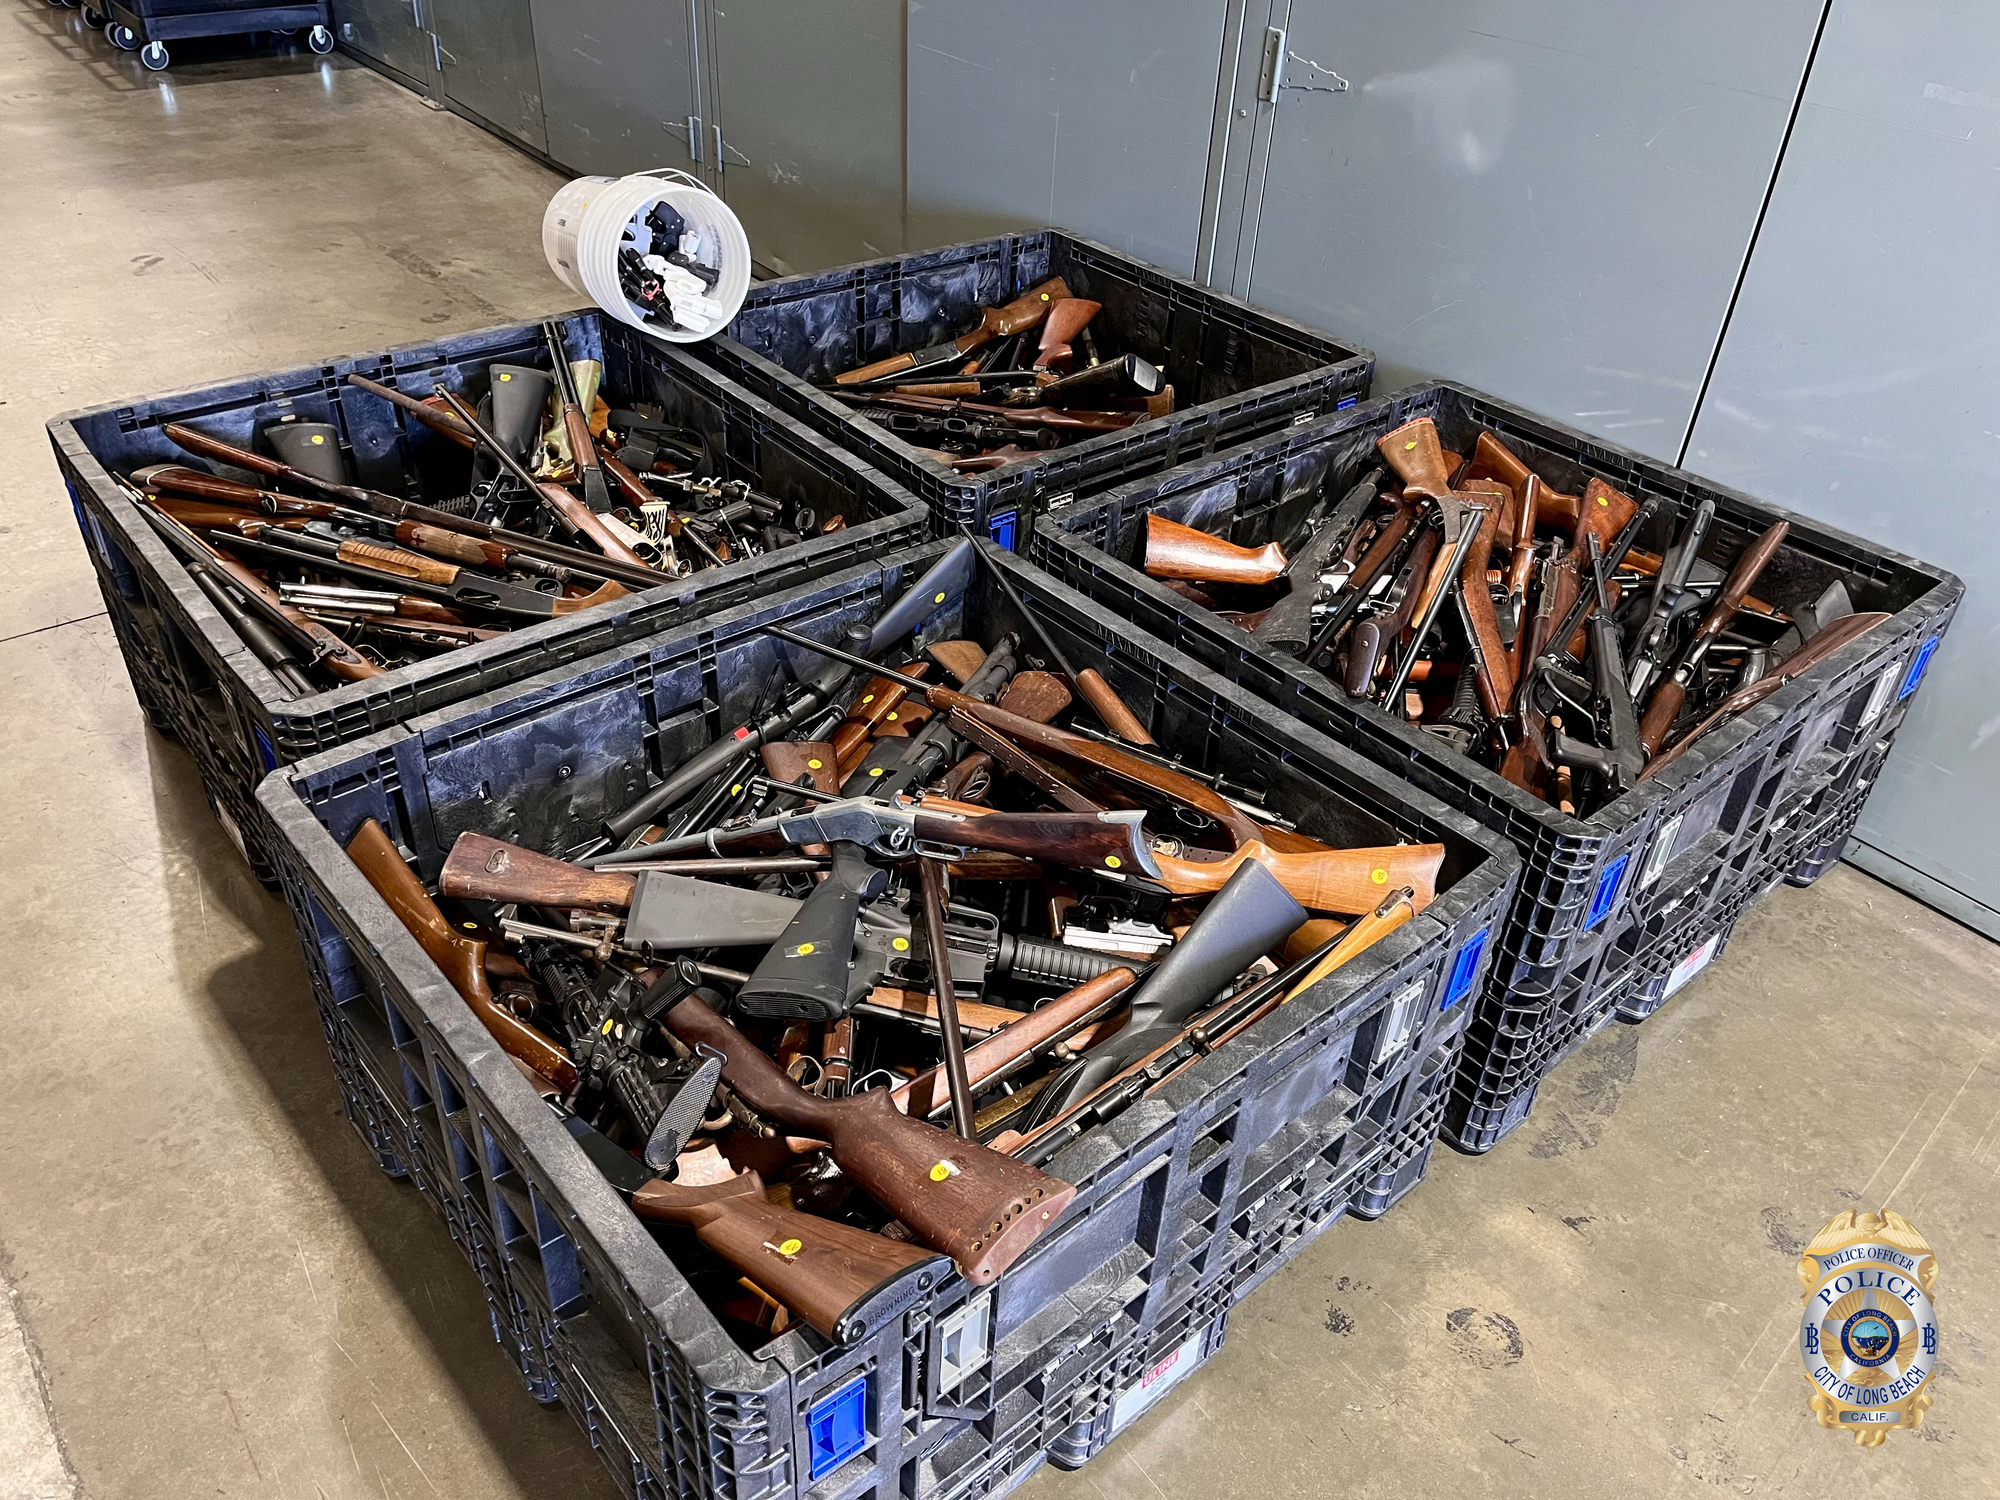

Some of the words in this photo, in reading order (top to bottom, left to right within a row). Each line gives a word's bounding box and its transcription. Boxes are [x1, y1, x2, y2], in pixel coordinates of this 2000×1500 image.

[1096, 624, 1156, 668] MAXIMUM
[1228, 702, 1257, 730] FILL
[868, 1286, 915, 1326] BROWNING
[1143, 1352, 1178, 1386] ULINE
